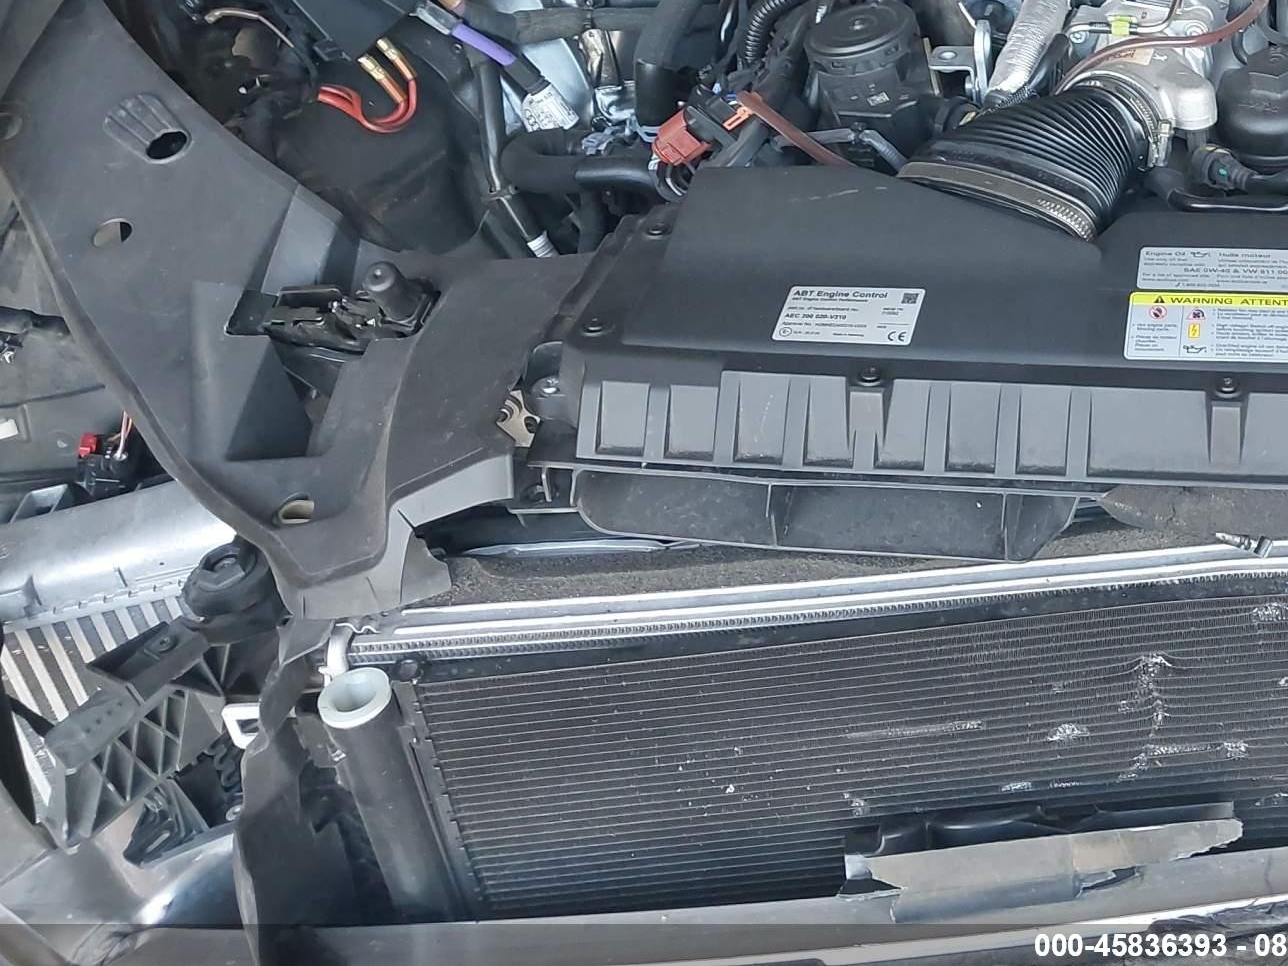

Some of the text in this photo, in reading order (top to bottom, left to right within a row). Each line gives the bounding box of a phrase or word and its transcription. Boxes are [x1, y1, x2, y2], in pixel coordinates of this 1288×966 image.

[816, 290, 850, 298] Engine
[852, 290, 888, 299] Control
[1170, 297, 1233, 305] WARNING
